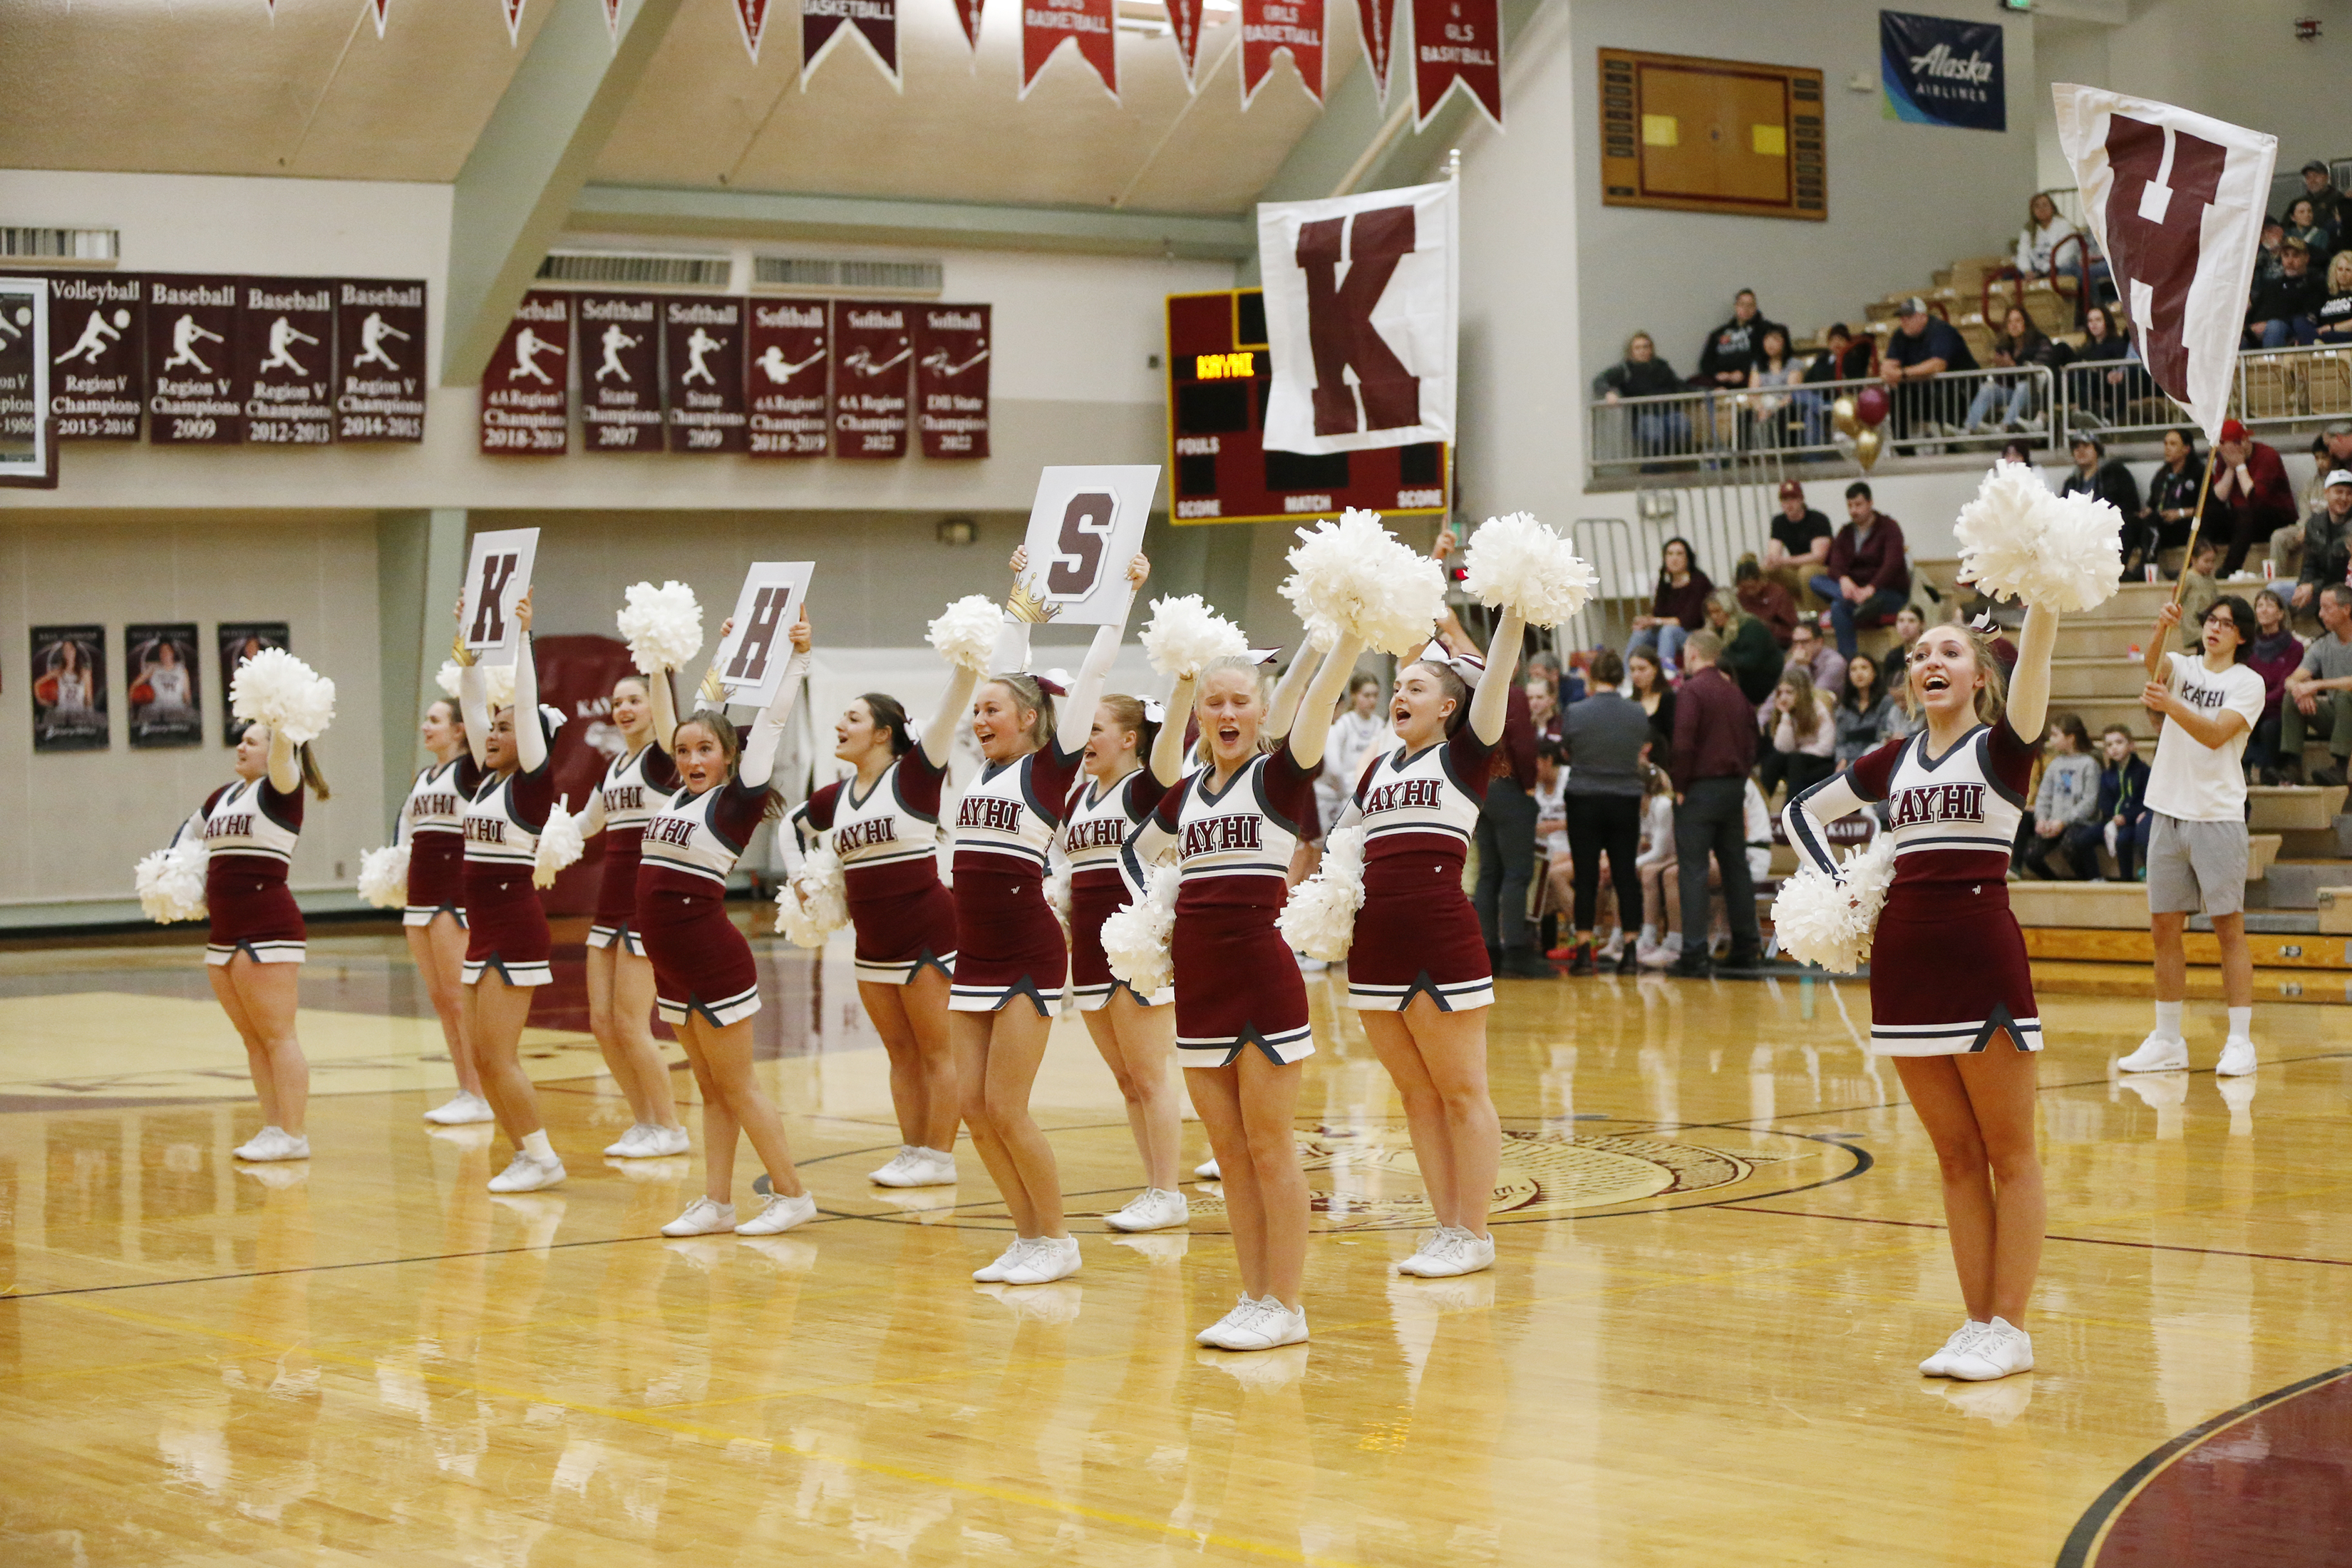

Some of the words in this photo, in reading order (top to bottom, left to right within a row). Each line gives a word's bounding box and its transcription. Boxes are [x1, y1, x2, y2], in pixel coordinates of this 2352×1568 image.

[1909, 43, 1993, 86] Alaska
[1915, 82, 1988, 103] AIRLINES
[51, 279, 140, 306] Volleyball
[152, 283, 235, 306] Baseball
[247, 287, 331, 312] Baseball
[341, 284, 423, 308] Baseball
[582, 298, 654, 321] Softball
[667, 302, 738, 325] Softball
[755, 306, 825, 329] Softball
[847, 309, 904, 329] Softball
[927, 311, 983, 331] Softball
[1296, 204, 1420, 438] K
[65, 374, 116, 394] Region
[116, 374, 128, 391] V
[157, 377, 215, 398] Region
[217, 378, 232, 396] V
[253, 380, 311, 403] Region
[313, 381, 327, 401] V
[346, 376, 401, 396] Region
[403, 377, 417, 396] V
[51, 396, 141, 416] Champions
[150, 396, 241, 418] Champions
[58, 418, 136, 435] 2015-2016
[172, 418, 217, 439] 2009
[1176, 435, 1221, 455] FOULS
[1177, 498, 1222, 518] SCORE
[1284, 494, 1332, 513] MATCH
[1396, 488, 1443, 508] SCORE
[1045, 490, 1117, 597] S
[467, 550, 521, 646] K
[723, 584, 792, 683] H
[413, 794, 457, 816] AYHI
[604, 785, 644, 813] AYHI
[205, 813, 254, 839] AYHI
[956, 797, 1023, 832] AYHI
[642, 816, 697, 848] AYHI
[832, 817, 897, 855] AYHI
[1065, 818, 1125, 853] AYHI
